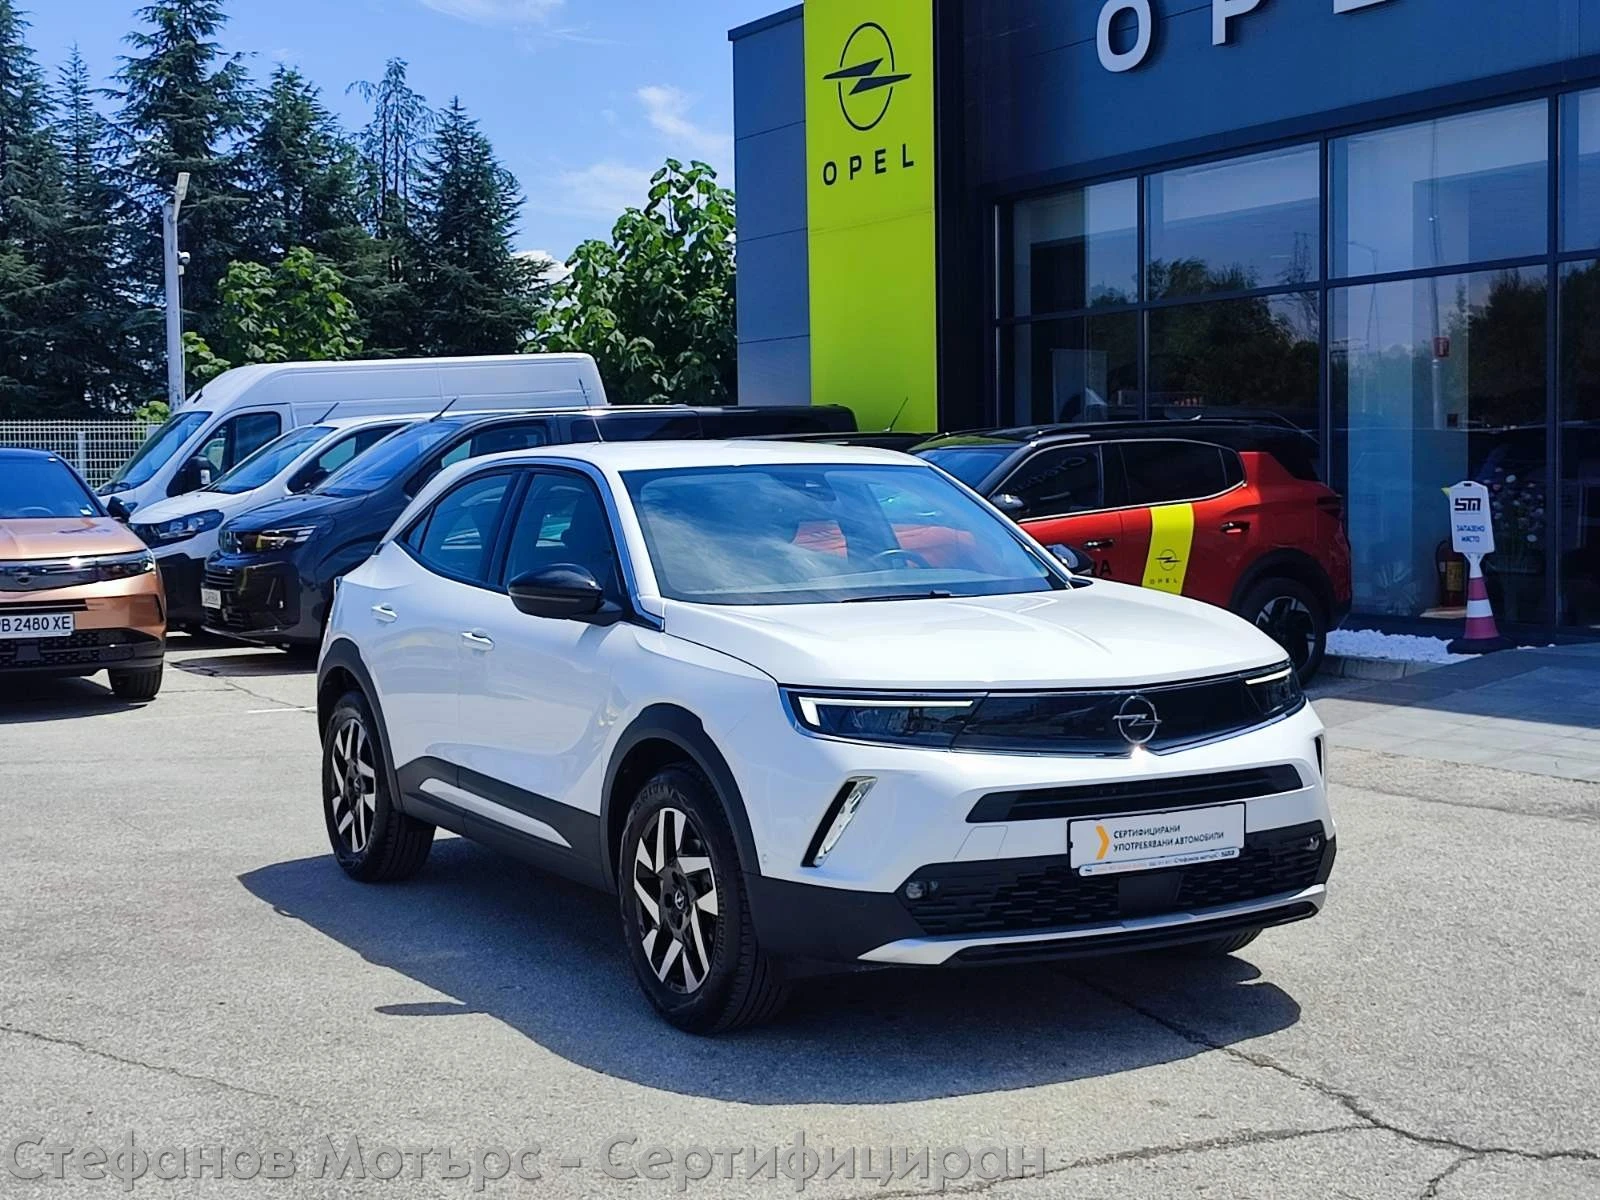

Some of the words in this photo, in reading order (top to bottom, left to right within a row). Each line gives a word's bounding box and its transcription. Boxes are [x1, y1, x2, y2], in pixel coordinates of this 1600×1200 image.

[1096, 0, 1388, 73] OP
[823, 143, 914, 186] OPEL
[0, 618, 11, 632] B
[14, 617, 49, 631] 2480
[52, 616, 71, 630] XE
[1113, 825, 1180, 839] СЕРТИФИЦИРАНИ
[1113, 839, 1173, 852] УПОТРЕБЯВАНИ
[1174, 832, 1225, 846] АВТОМОБИЛИ
